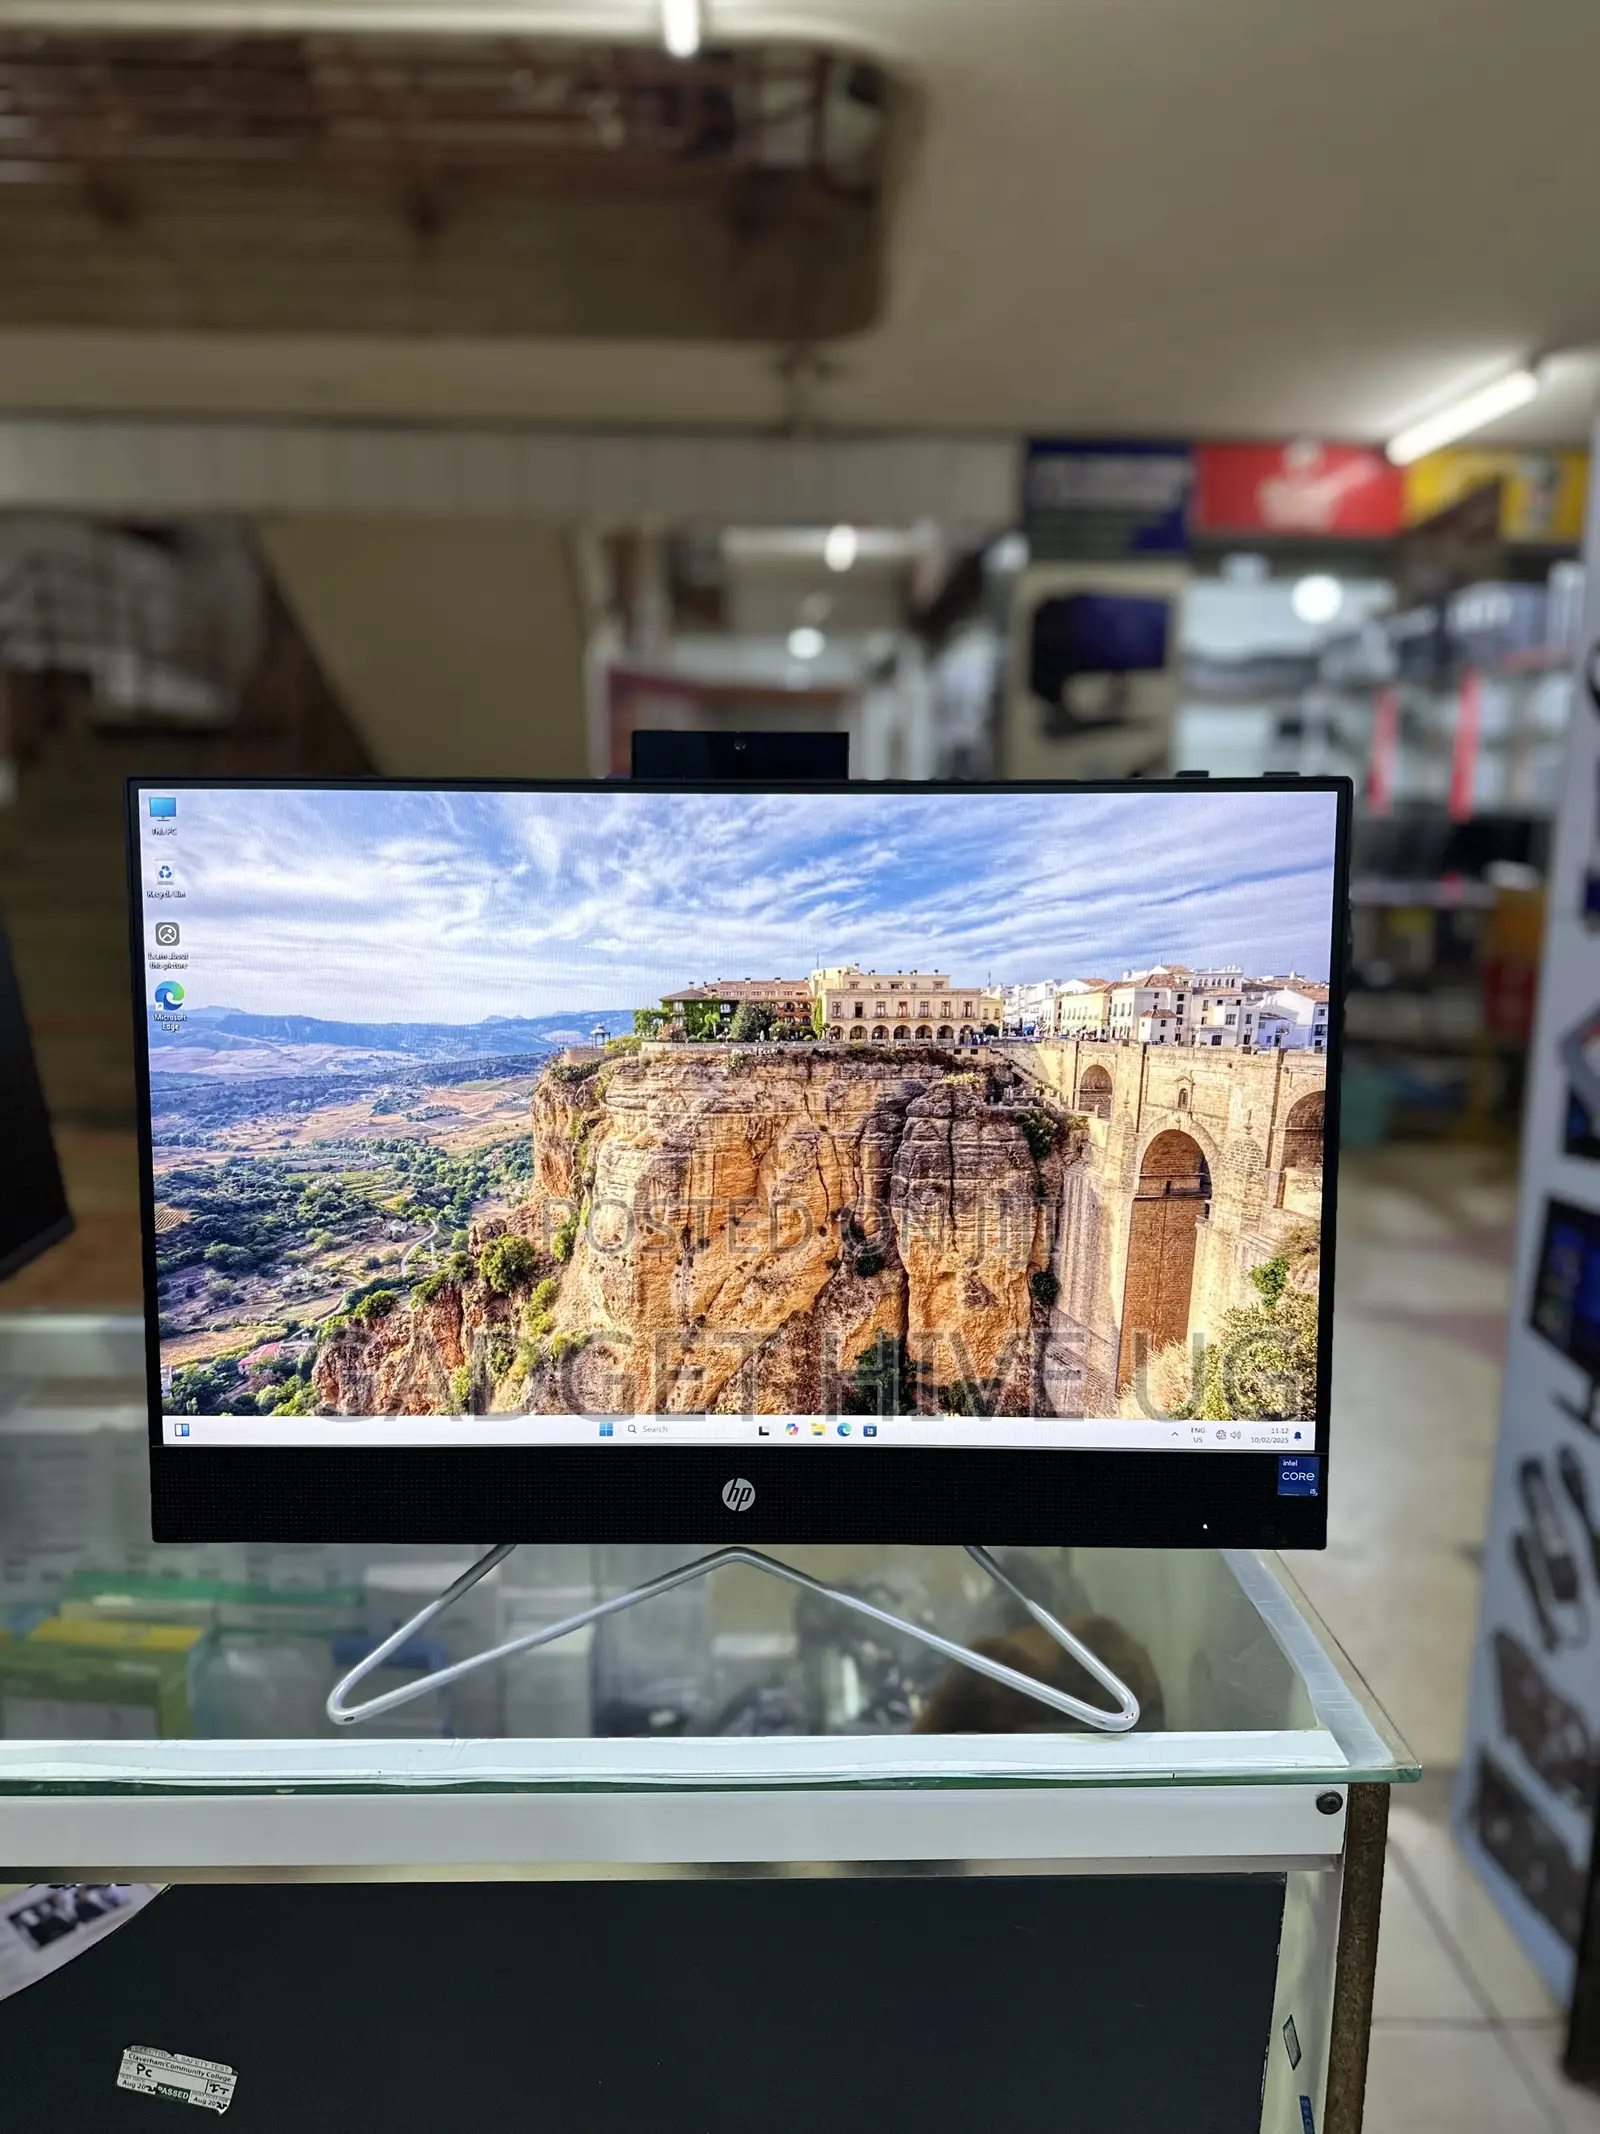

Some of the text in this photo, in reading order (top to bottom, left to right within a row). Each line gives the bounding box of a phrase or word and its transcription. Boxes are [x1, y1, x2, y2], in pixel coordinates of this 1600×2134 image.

[162, 1023, 179, 1031] Edge
[642, 1424, 669, 1434] Search
[722, 1478, 755, 1512] hp
[128, 2053, 165, 2067] Claverham
[165, 2063, 205, 2076] Community
[206, 2071, 232, 2082] College
[211, 2064, 229, 2072] TEST
[122, 2080, 136, 2089] Aug
[157, 2086, 188, 2100] PASSED
[193, 2097, 207, 2105] Aug
